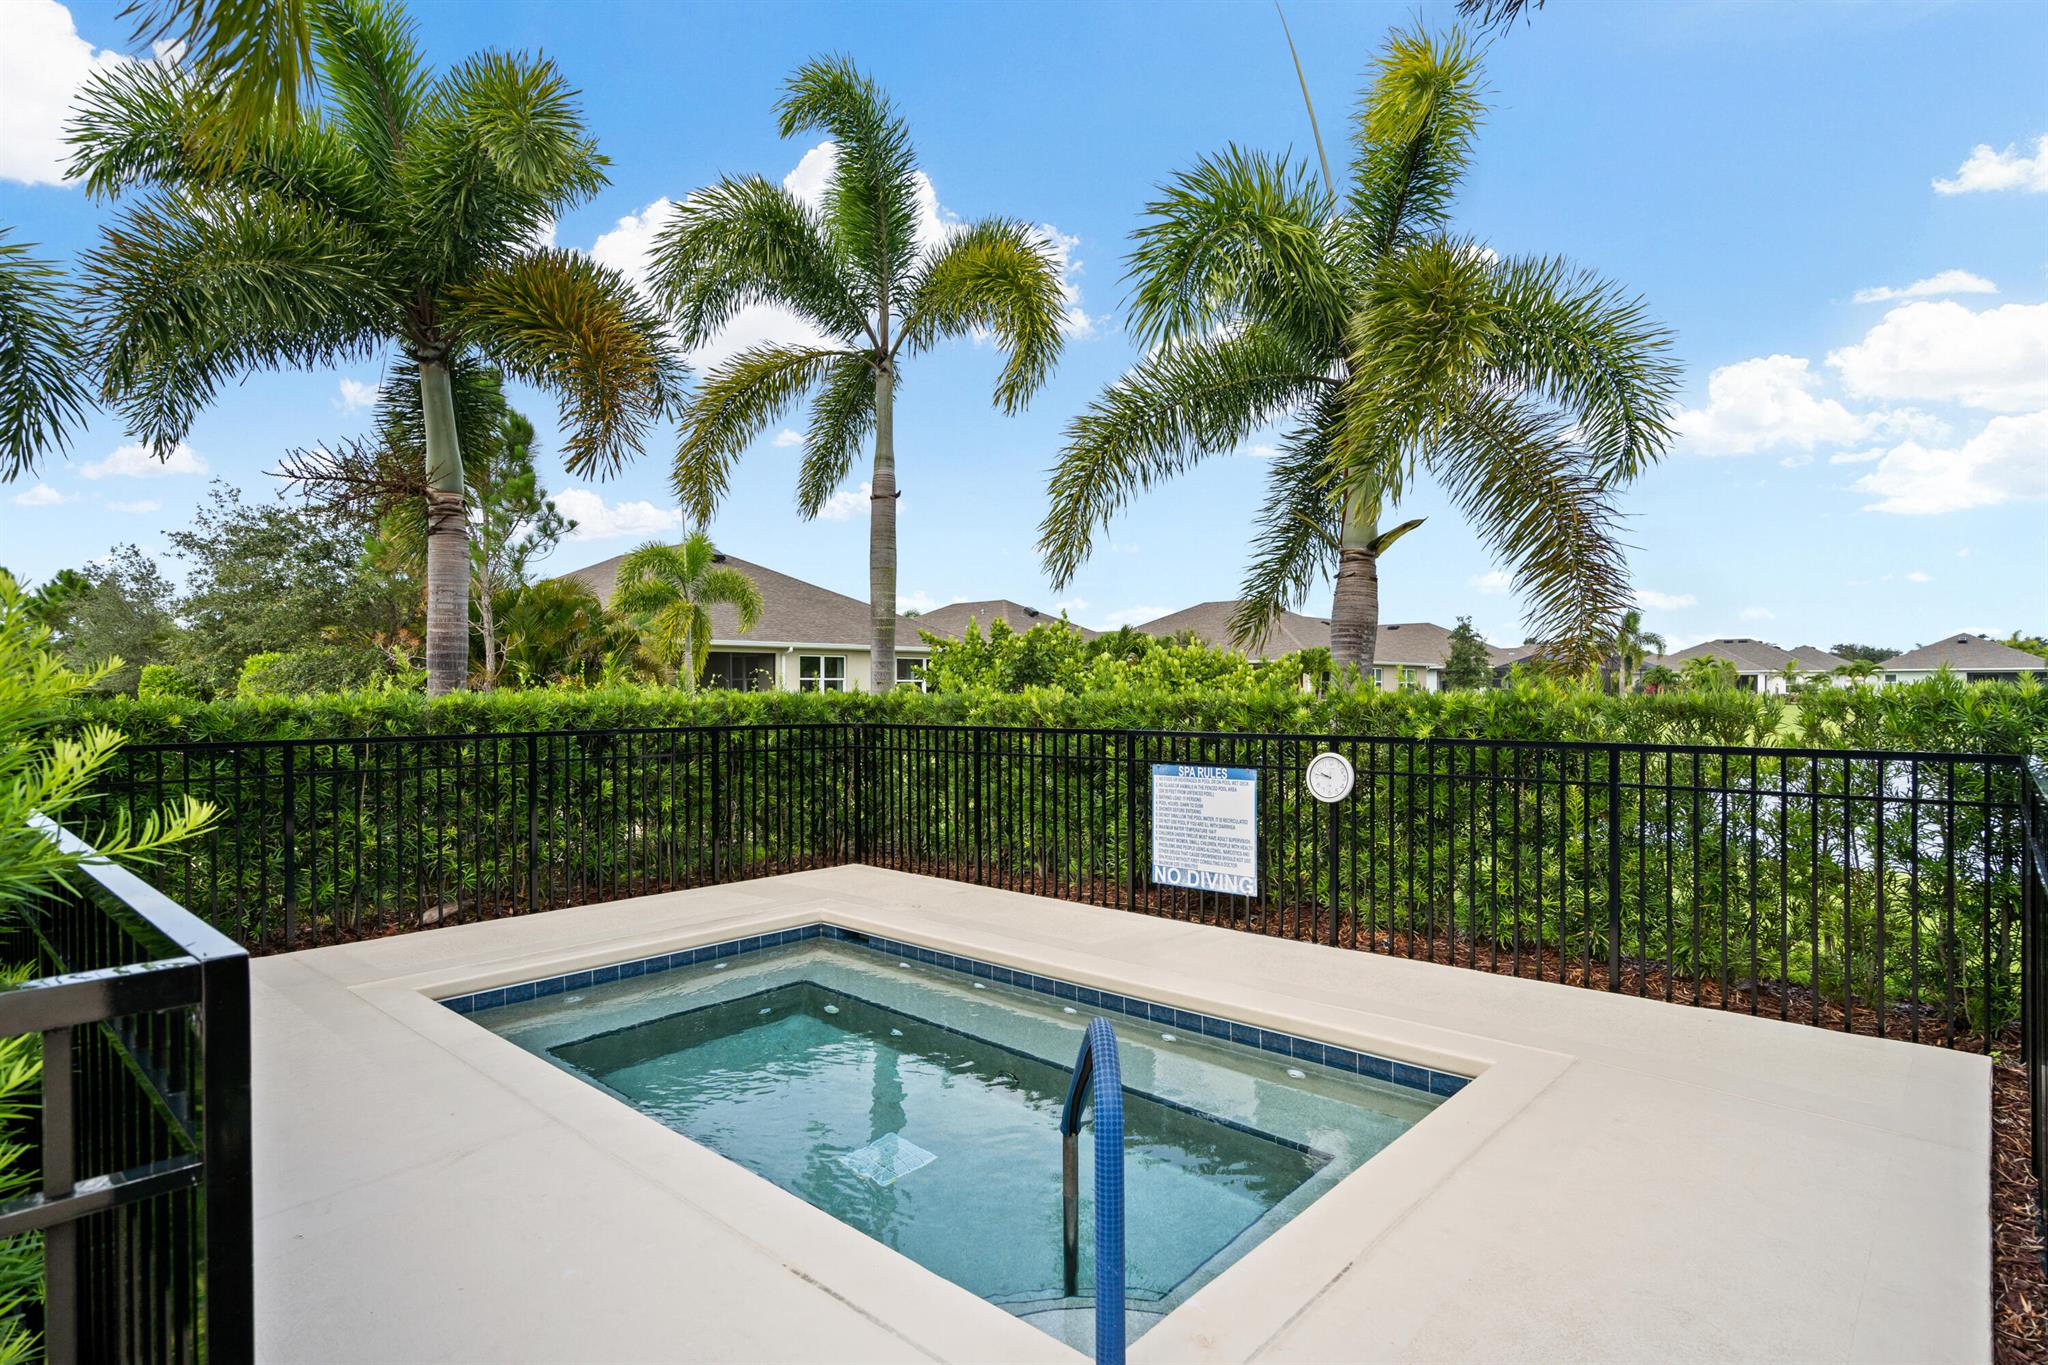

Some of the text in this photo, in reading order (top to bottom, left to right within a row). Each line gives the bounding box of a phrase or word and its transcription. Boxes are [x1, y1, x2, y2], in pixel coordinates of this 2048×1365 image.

[1178, 766, 1228, 779] SPA RULES
[1154, 866, 1253, 894] NO DIVING
